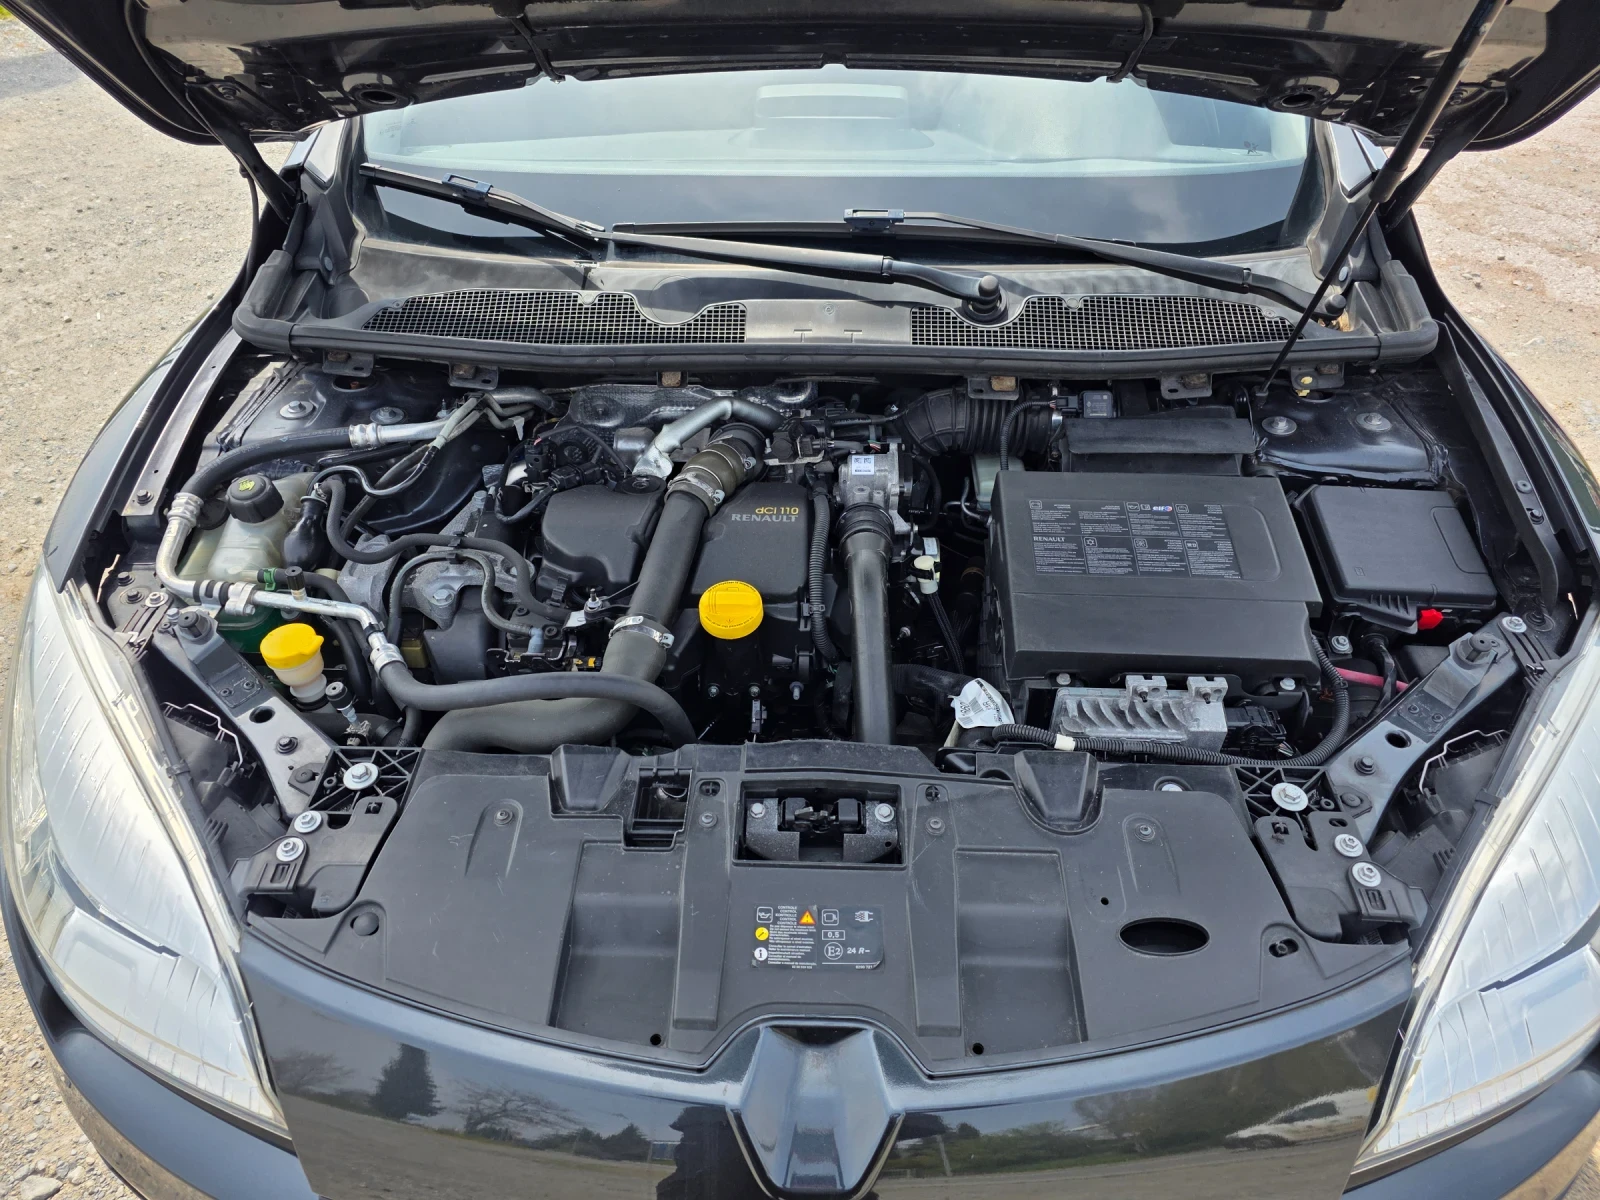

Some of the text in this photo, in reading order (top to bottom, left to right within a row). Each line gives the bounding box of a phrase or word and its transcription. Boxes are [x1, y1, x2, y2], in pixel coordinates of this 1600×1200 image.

[780, 506, 799, 515] 110
[731, 513, 799, 523] RENAULT
[827, 931, 840, 939] 0,5
[827, 945, 841, 957] E2
